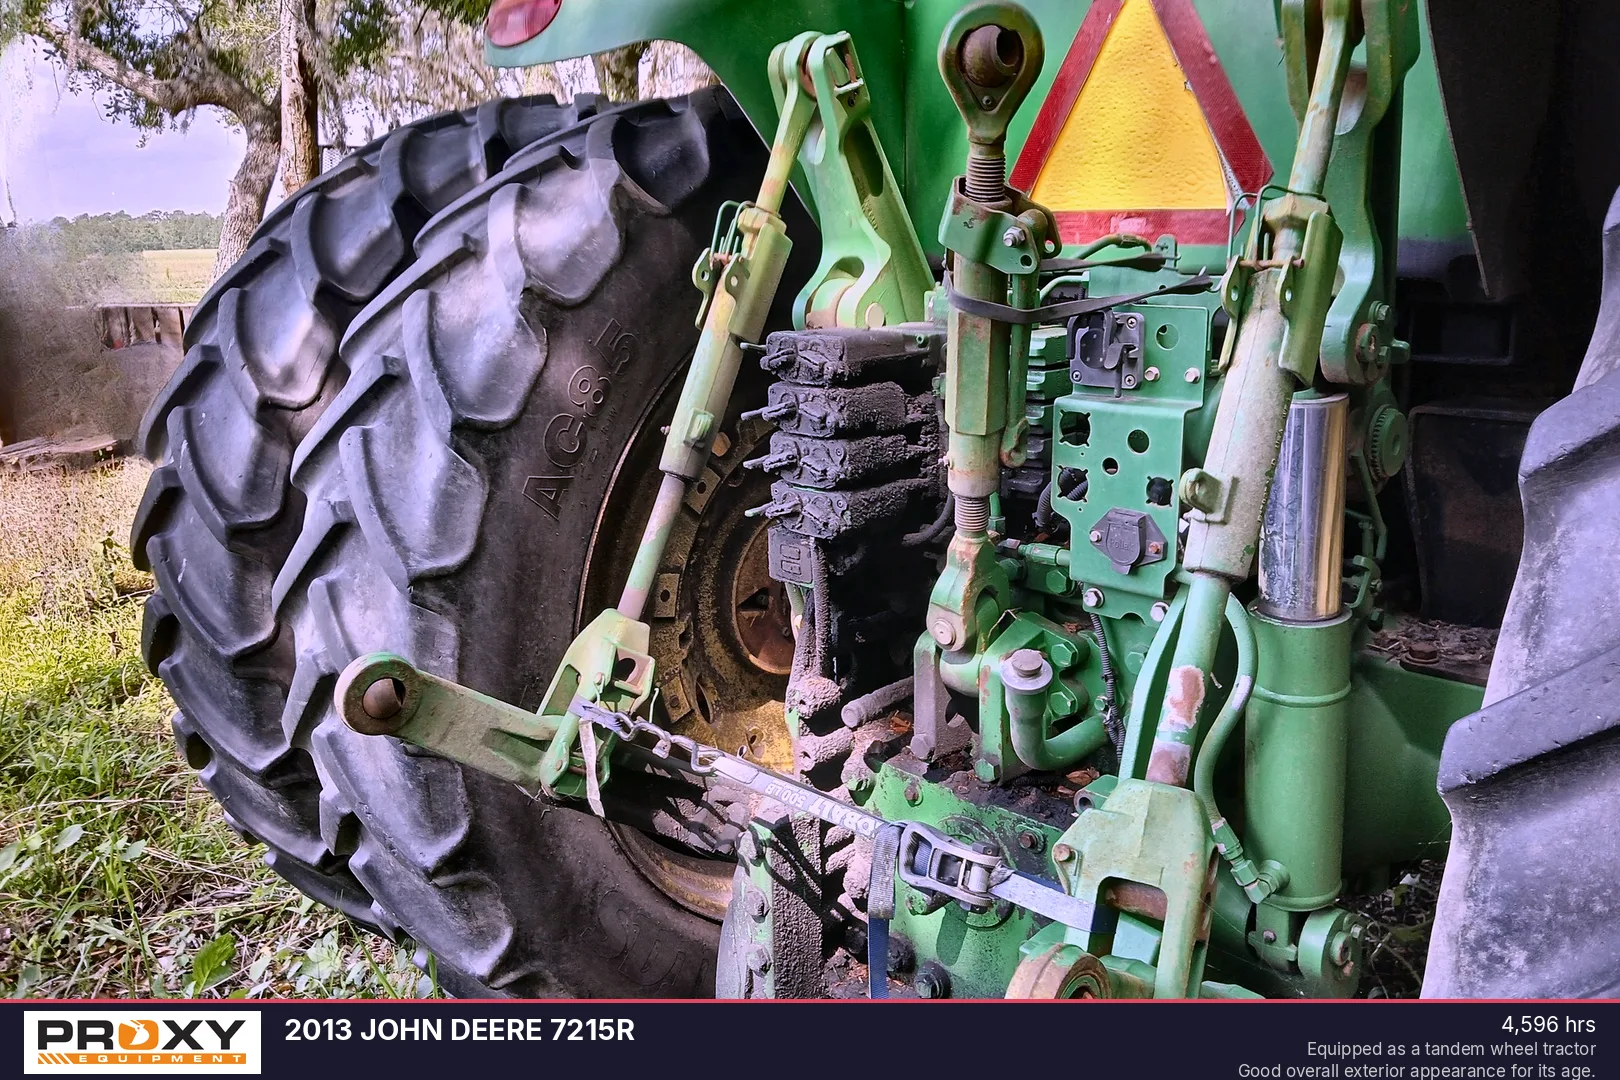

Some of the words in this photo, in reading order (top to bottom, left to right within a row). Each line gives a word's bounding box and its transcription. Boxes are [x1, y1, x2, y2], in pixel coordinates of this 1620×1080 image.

[521, 318, 638, 521] AC85
[765, 784, 783, 798] LB
[783, 792, 807, 807] 500
[810, 798, 884, 839] OBALT
